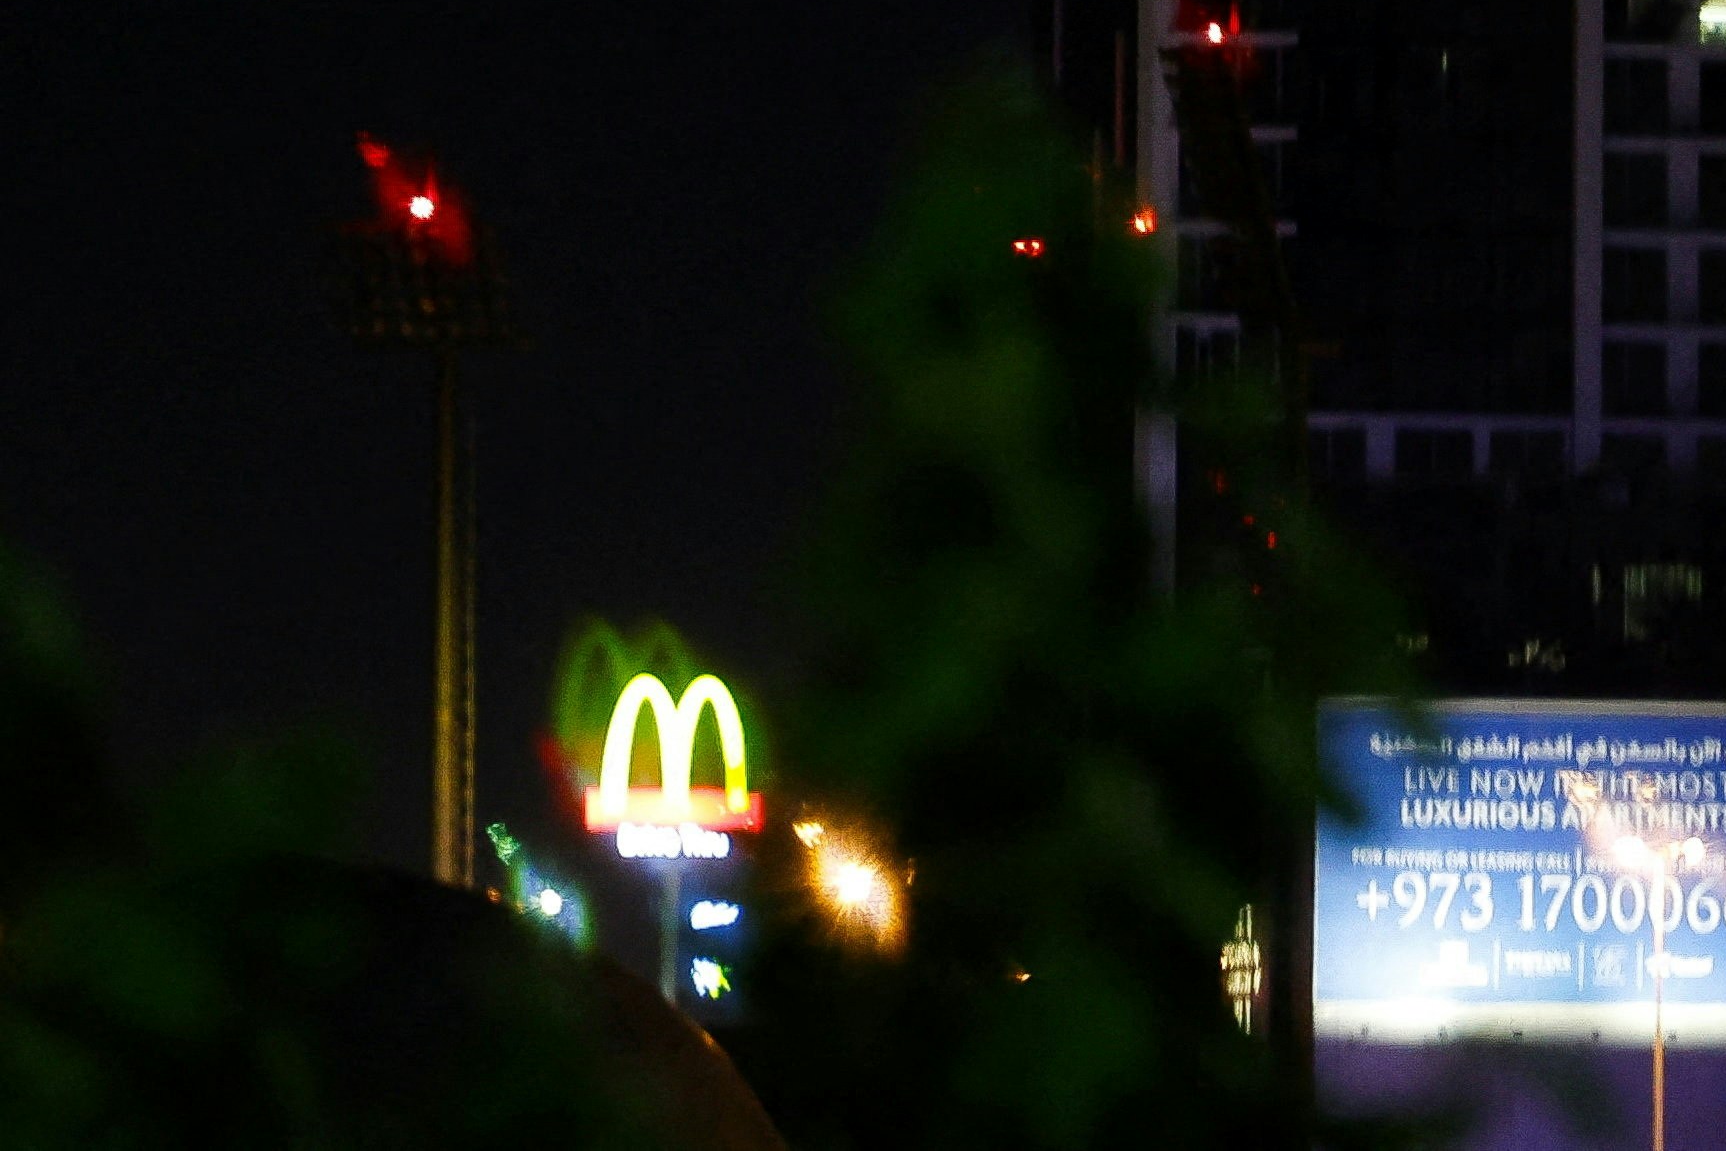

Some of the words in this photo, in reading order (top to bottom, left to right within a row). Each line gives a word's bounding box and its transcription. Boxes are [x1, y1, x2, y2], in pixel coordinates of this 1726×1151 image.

[1404, 766, 1459, 797] LIVE
[1470, 768, 1546, 799] NOW
[1400, 798, 1556, 830] LUXURIOUS
[1356, 871, 1495, 932] +973
